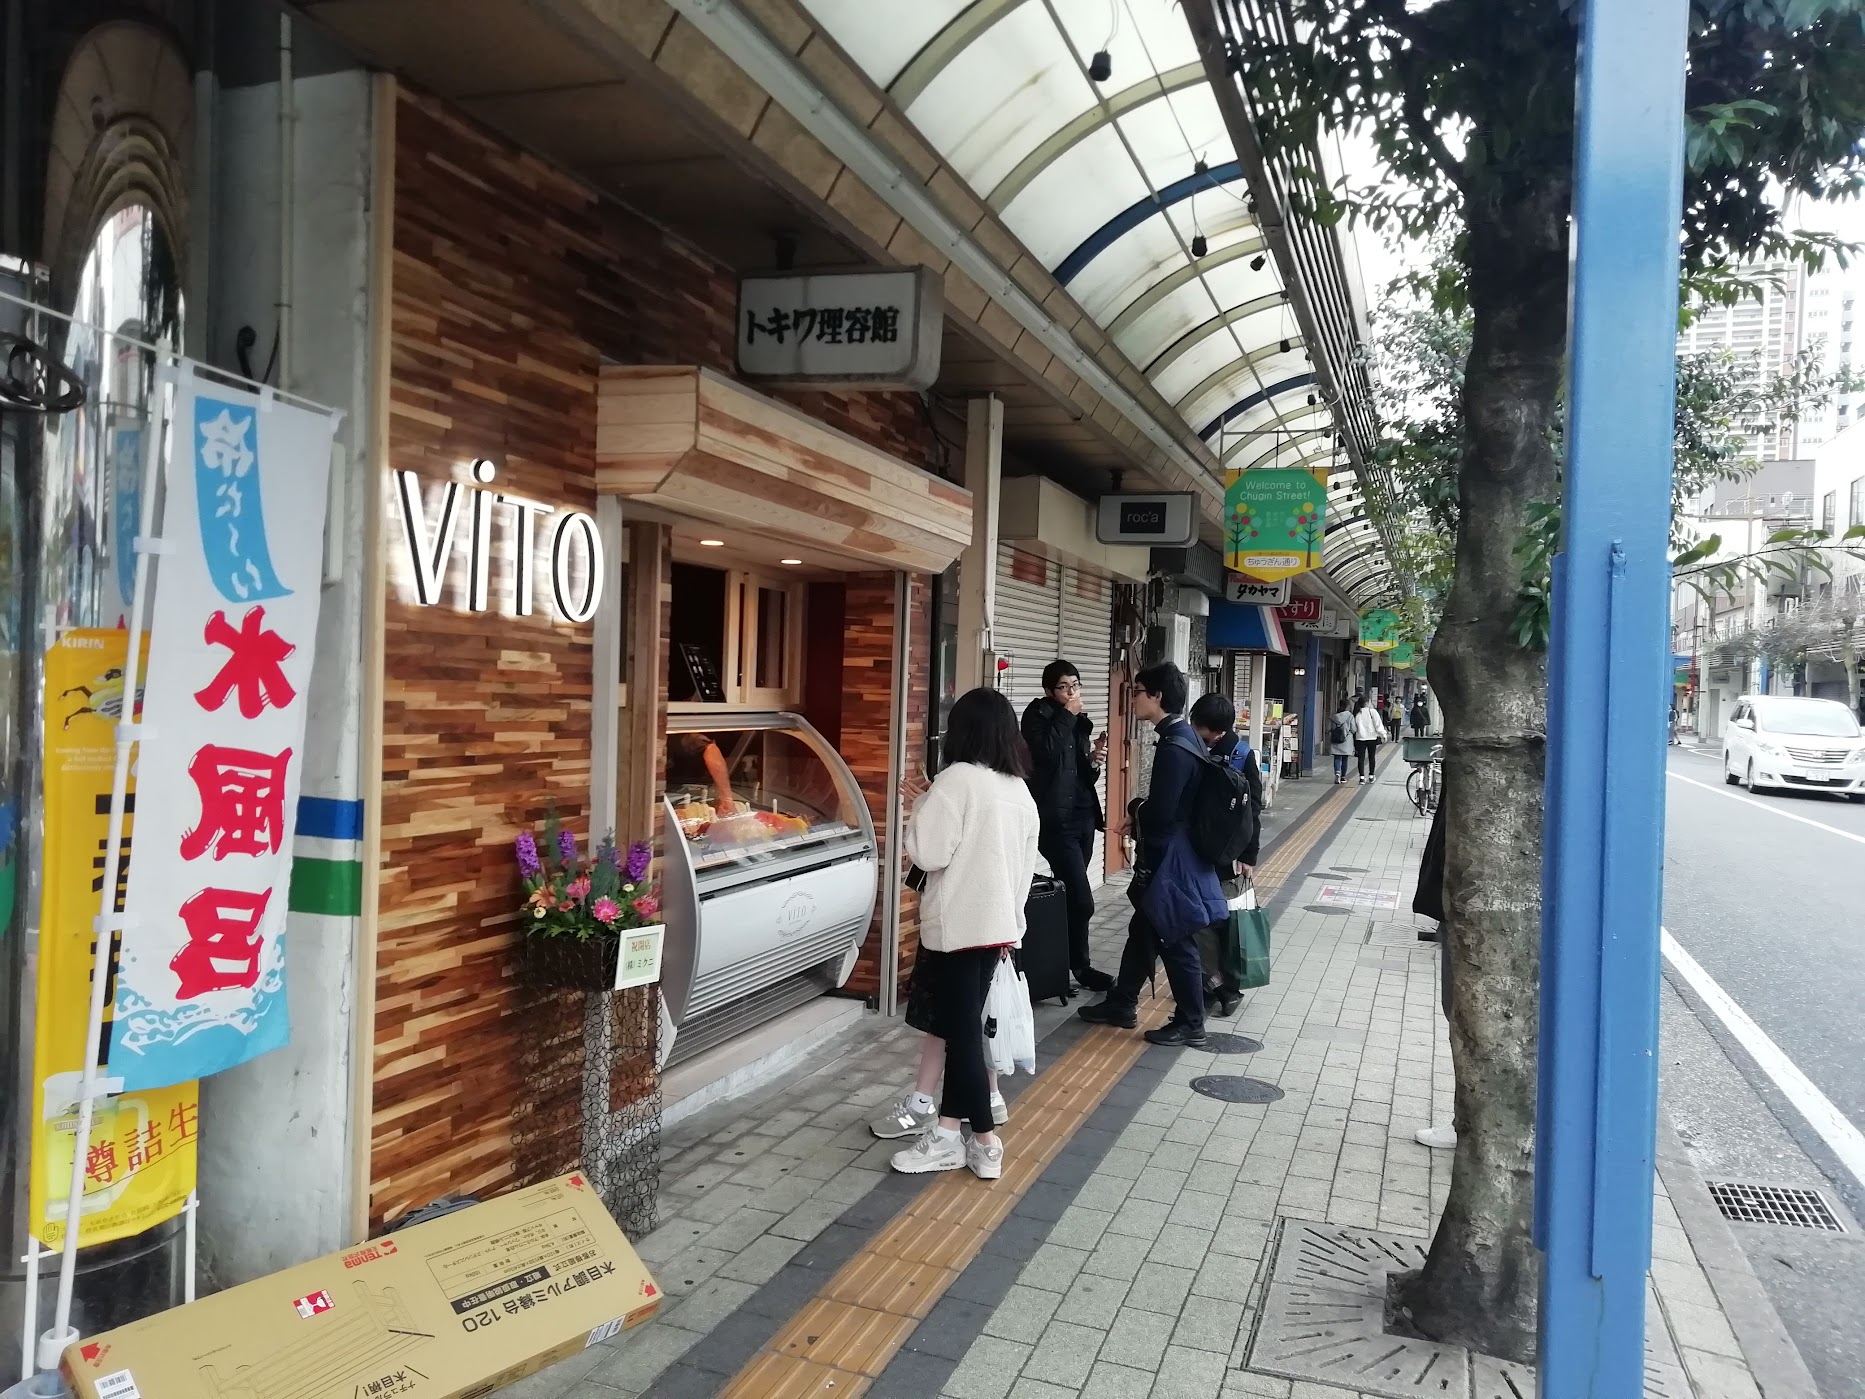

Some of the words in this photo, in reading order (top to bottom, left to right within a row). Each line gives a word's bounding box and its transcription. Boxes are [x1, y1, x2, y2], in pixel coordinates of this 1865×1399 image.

[747, 305, 900, 344] トキワ理容館
[1245, 481, 1292, 490] Welcome
[1296, 481, 1307, 490] to
[1240, 491, 1273, 501] Chugin
[1276, 490, 1311, 500] Street!
[1247, 557, 1298, 567] ちゅうぎん通り
[1237, 584, 1280, 599] タカヤマ
[62, 638, 104, 649] KIRIN
[897, 1114, 916, 1130] N
[552, 1249, 597, 1272] お客様組立式
[502, 1261, 617, 1315] 木目調アルミ縁台
[461, 1308, 502, 1333] 120
[362, 1370, 408, 1398] 木目柄!
